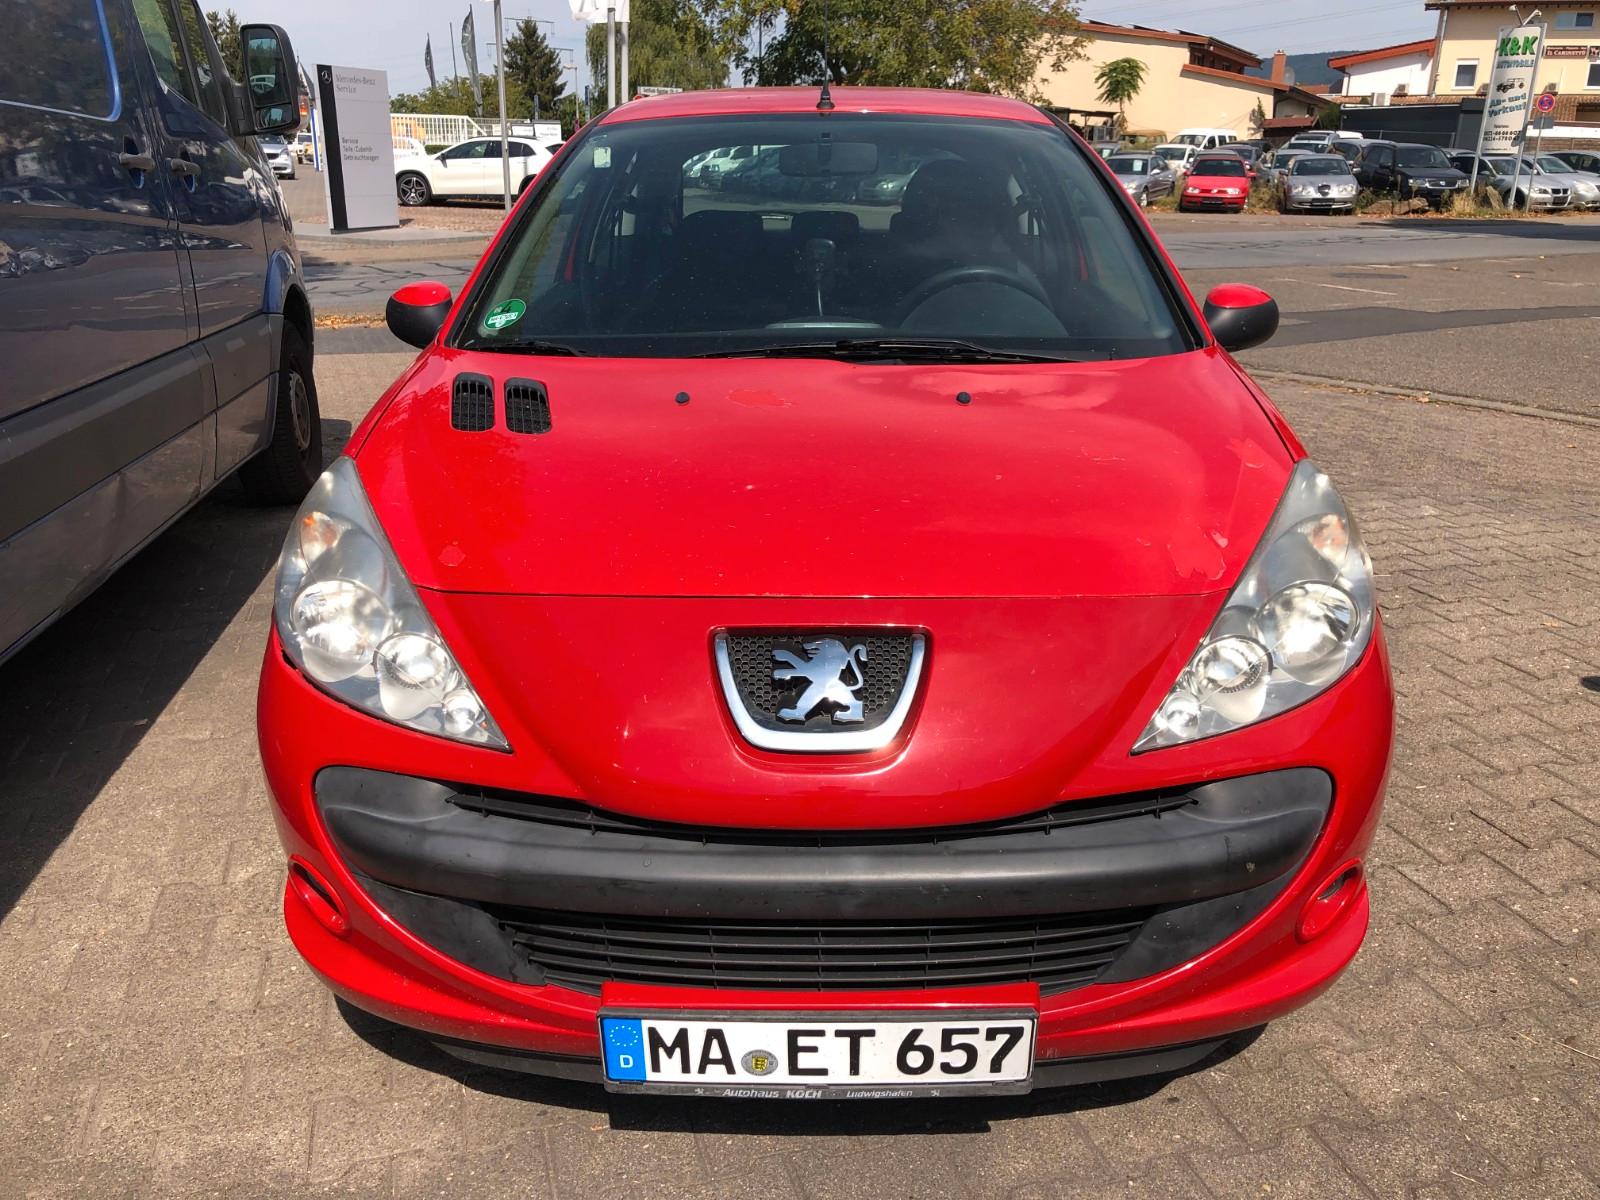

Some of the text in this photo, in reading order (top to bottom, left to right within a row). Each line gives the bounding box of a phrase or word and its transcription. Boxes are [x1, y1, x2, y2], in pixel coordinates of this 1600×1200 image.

[1499, 36, 1538, 56] K&K
[619, 1025, 1025, 1077] D MA ET 657
[721, 1088, 914, 1100] Autohaus KOCH Ludwigshafen
